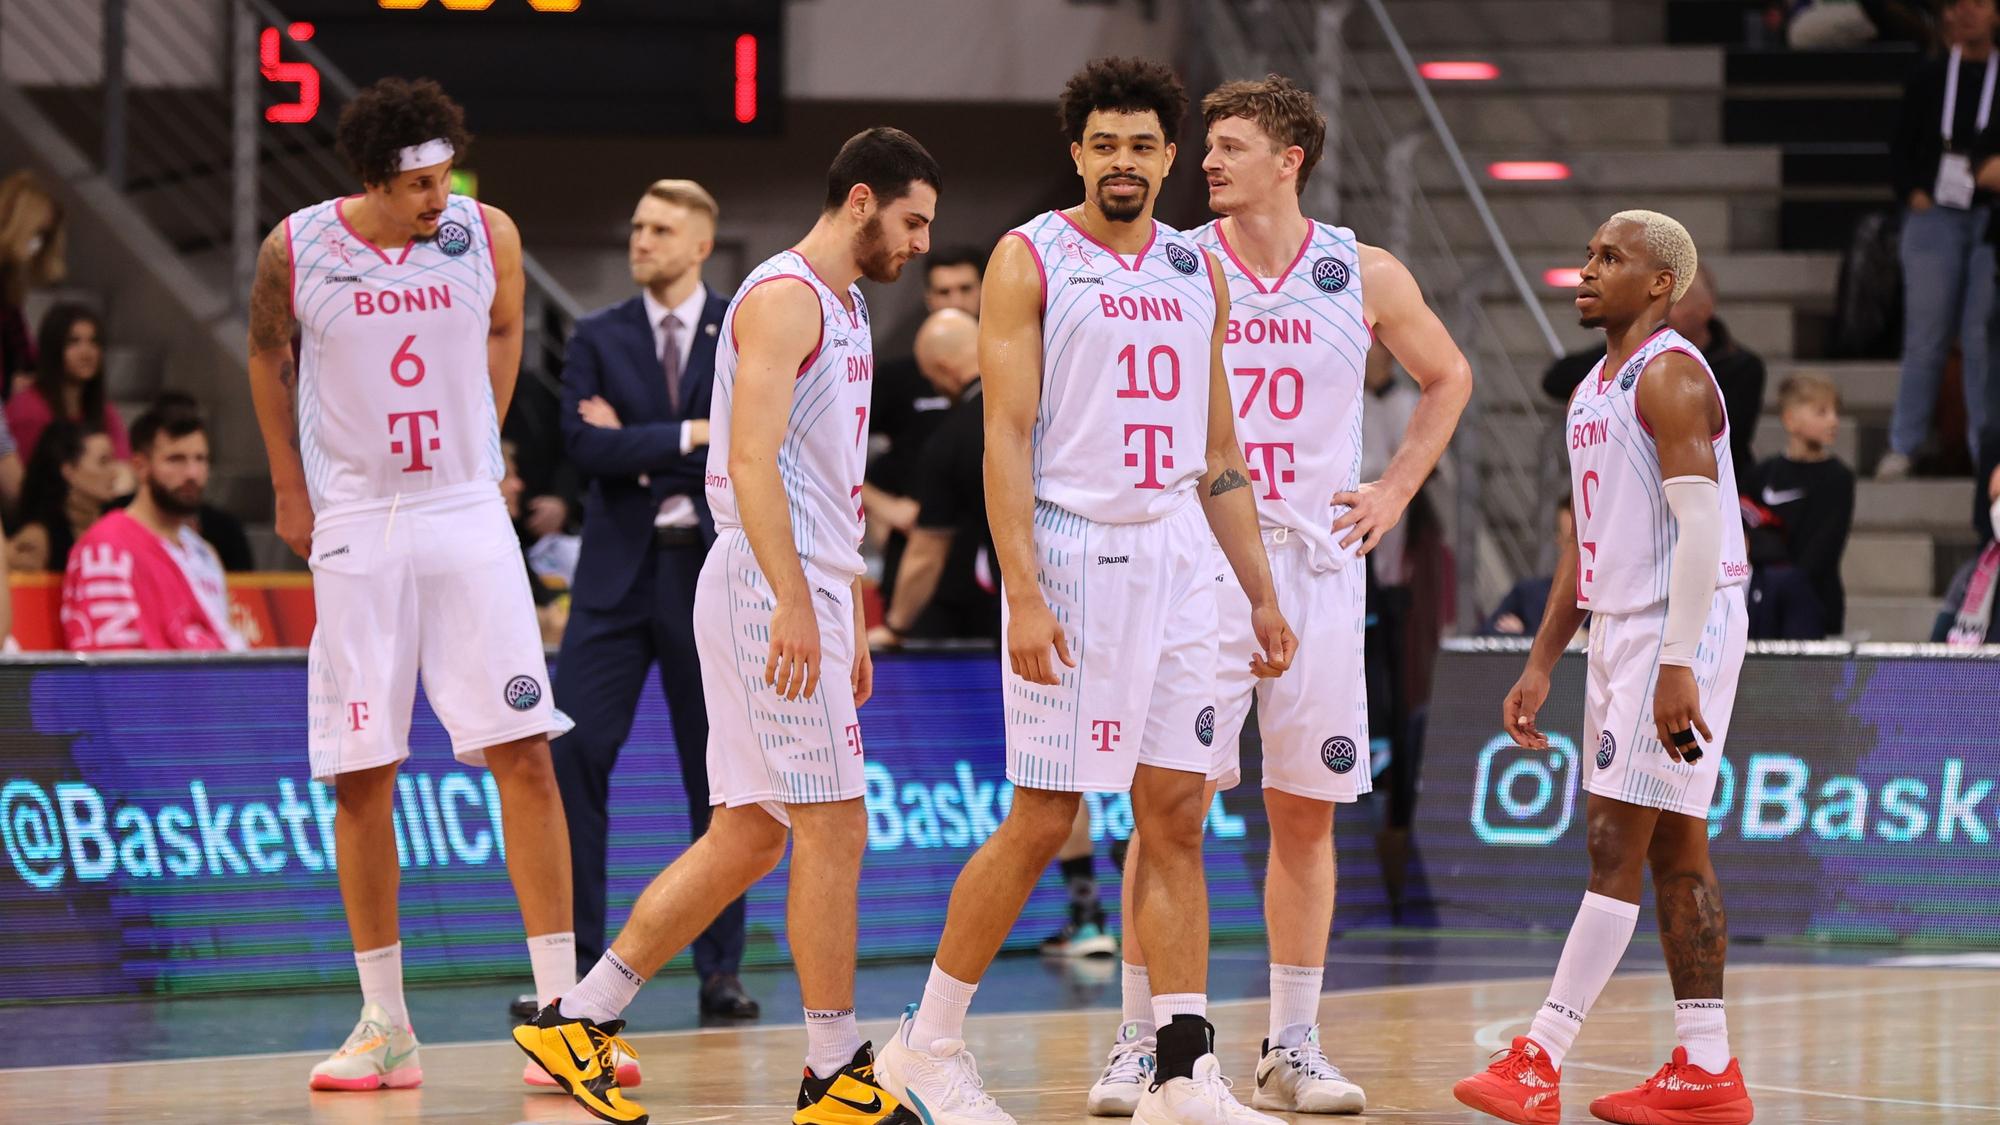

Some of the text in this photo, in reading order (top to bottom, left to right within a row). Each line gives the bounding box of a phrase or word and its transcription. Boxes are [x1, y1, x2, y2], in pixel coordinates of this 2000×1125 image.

[260, 22, 319, 122] 5
[735, 34, 757, 123] 1
[354, 284, 452, 316] BONN
[1068, 276, 1104, 286] SPALDING
[1099, 293, 1183, 322] BONN
[1224, 318, 1312, 345] BONN
[390, 334, 426, 387] 6
[1116, 344, 1181, 401] 10
[1233, 367, 1304, 420] 70
[388, 410, 441, 473] T
[855, 406, 867, 452] 7
[1124, 424, 1174, 489] T
[1092, 720, 1120, 751] T
